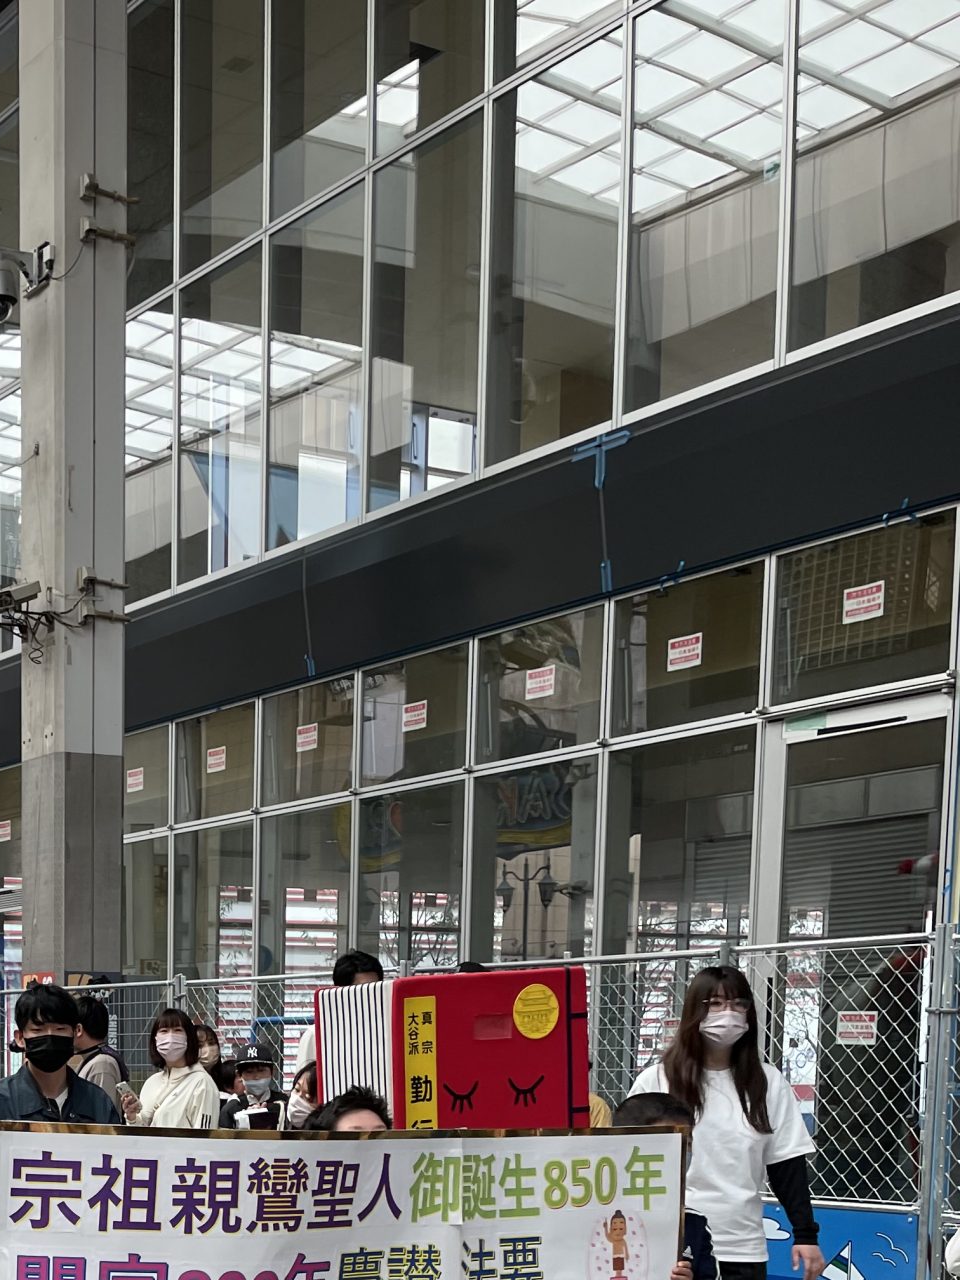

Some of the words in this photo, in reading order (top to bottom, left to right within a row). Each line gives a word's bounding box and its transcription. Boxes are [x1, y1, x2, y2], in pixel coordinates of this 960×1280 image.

[407, 1012, 420, 1055] 大谷派
[421, 1011, 433, 1054] 真宗
